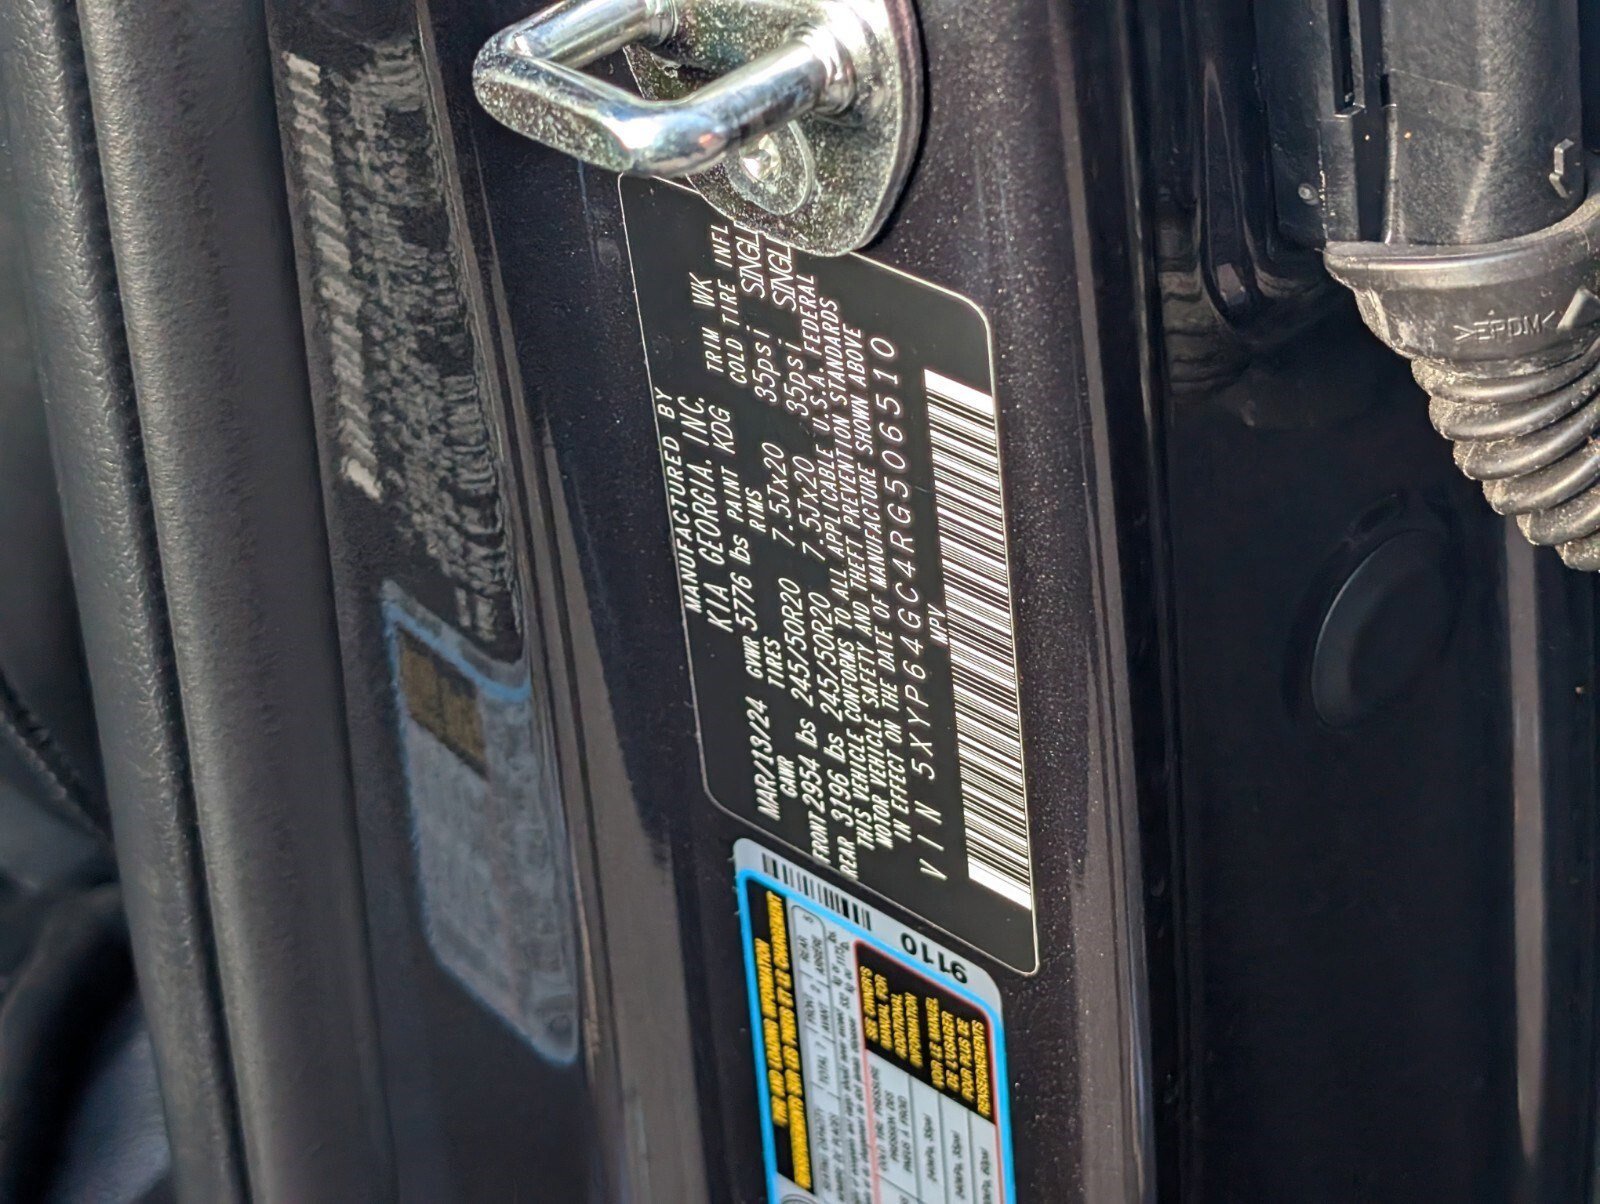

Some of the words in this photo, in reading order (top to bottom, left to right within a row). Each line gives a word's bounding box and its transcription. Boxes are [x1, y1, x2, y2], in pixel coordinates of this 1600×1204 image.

[710, 224, 733, 268] INFL
[688, 272, 715, 307] WK
[717, 278, 740, 326] TIRE
[795, 274, 822, 356] FEDERAL
[701, 326, 724, 373] TRIM
[725, 337, 748, 384] COLD
[746, 324, 781, 402] 35psi
[818, 296, 848, 406] STANDARDS
[842, 322, 867, 388] ABOVE
[777, 338, 813, 416] 35psi
[807, 367, 831, 432] U.S.A.
[654, 386, 675, 419] BY
[677, 396, 709, 446] INC.
[849, 393, 873, 455] SHOWN
[707, 404, 735, 454] KDG
[720, 465, 744, 522] PAINT
[761, 442, 795, 546] 7.5Jx20
[831, 413, 861, 529] PREVENTION
[661, 435, 702, 613] MANUFACTURED
[744, 486, 766, 533] RIMS
[792, 455, 825, 561] 7.5Jx20
[815, 443, 845, 558] APPLICABLE
[856, 462, 887, 589] MANUFACTURE
[728, 534, 751, 565] lbs
[845, 535, 868, 592] THEFT
[703, 582, 733, 632] KIA
[729, 571, 758, 631] 5776
[829, 567, 849, 601] ALL
[870, 593, 890, 619] OF
[777, 577, 814, 707] 245/50R20
[833, 606, 852, 629] TO
[852, 600, 872, 637] AND
[927, 603, 948, 645] MPV
[742, 635, 763, 678] GVWR
[762, 636, 785, 688] TIRES
[807, 591, 843, 722] 245/50R20
[856, 640, 879, 708] SAFETY
[874, 625, 896, 673] DATE
[836, 637, 862, 723] CONFORMS
[879, 677, 899, 712] THE
[795, 718, 818, 748] lbs
[823, 732, 846, 763] lbs
[863, 713, 887, 787] VEHICLE
[883, 718, 903, 744] ON
[745, 696, 780, 819] MAR/13/24
[776, 755, 798, 797] GAWR
[845, 728, 870, 801] VEHICLE
[886, 748, 909, 814] EFFECT
[797, 754, 825, 813] 2954
[826, 768, 854, 827] 3196
[808, 810, 830, 864] FRONT
[853, 807, 875, 850] THIS
[871, 793, 893, 848] MOTOR
[892, 818, 912, 842] IN
[836, 835, 858, 879] REAR
[767, 892, 788, 968] CHARGEMENT
[756, 939, 776, 1017] INFORMATION
[900, 932, 968, 984] 9110
[860, 966, 875, 1015] OWNER'S
[875, 974, 888, 999] FOR
[865, 1017, 878, 1040] SEE
[878, 1004, 891, 1048] MANUAL
[891, 994, 906, 1057] ADDITIONAL
[905, 993, 921, 1065] INFORMATION
[926, 998, 940, 1041] MANUEL
[942, 1011, 957, 1068] L'USAGER
[956, 1018, 969, 1036] DE
[929, 1042, 942, 1059] LE
[931, 1060, 944, 1087] VOIR
[958, 1037, 971, 1066] PLUS
[972, 1021, 989, 1114] RENSEIGNEMENTS
[946, 1070, 959, 1090] DE
[960, 1068, 974, 1100] POUR
